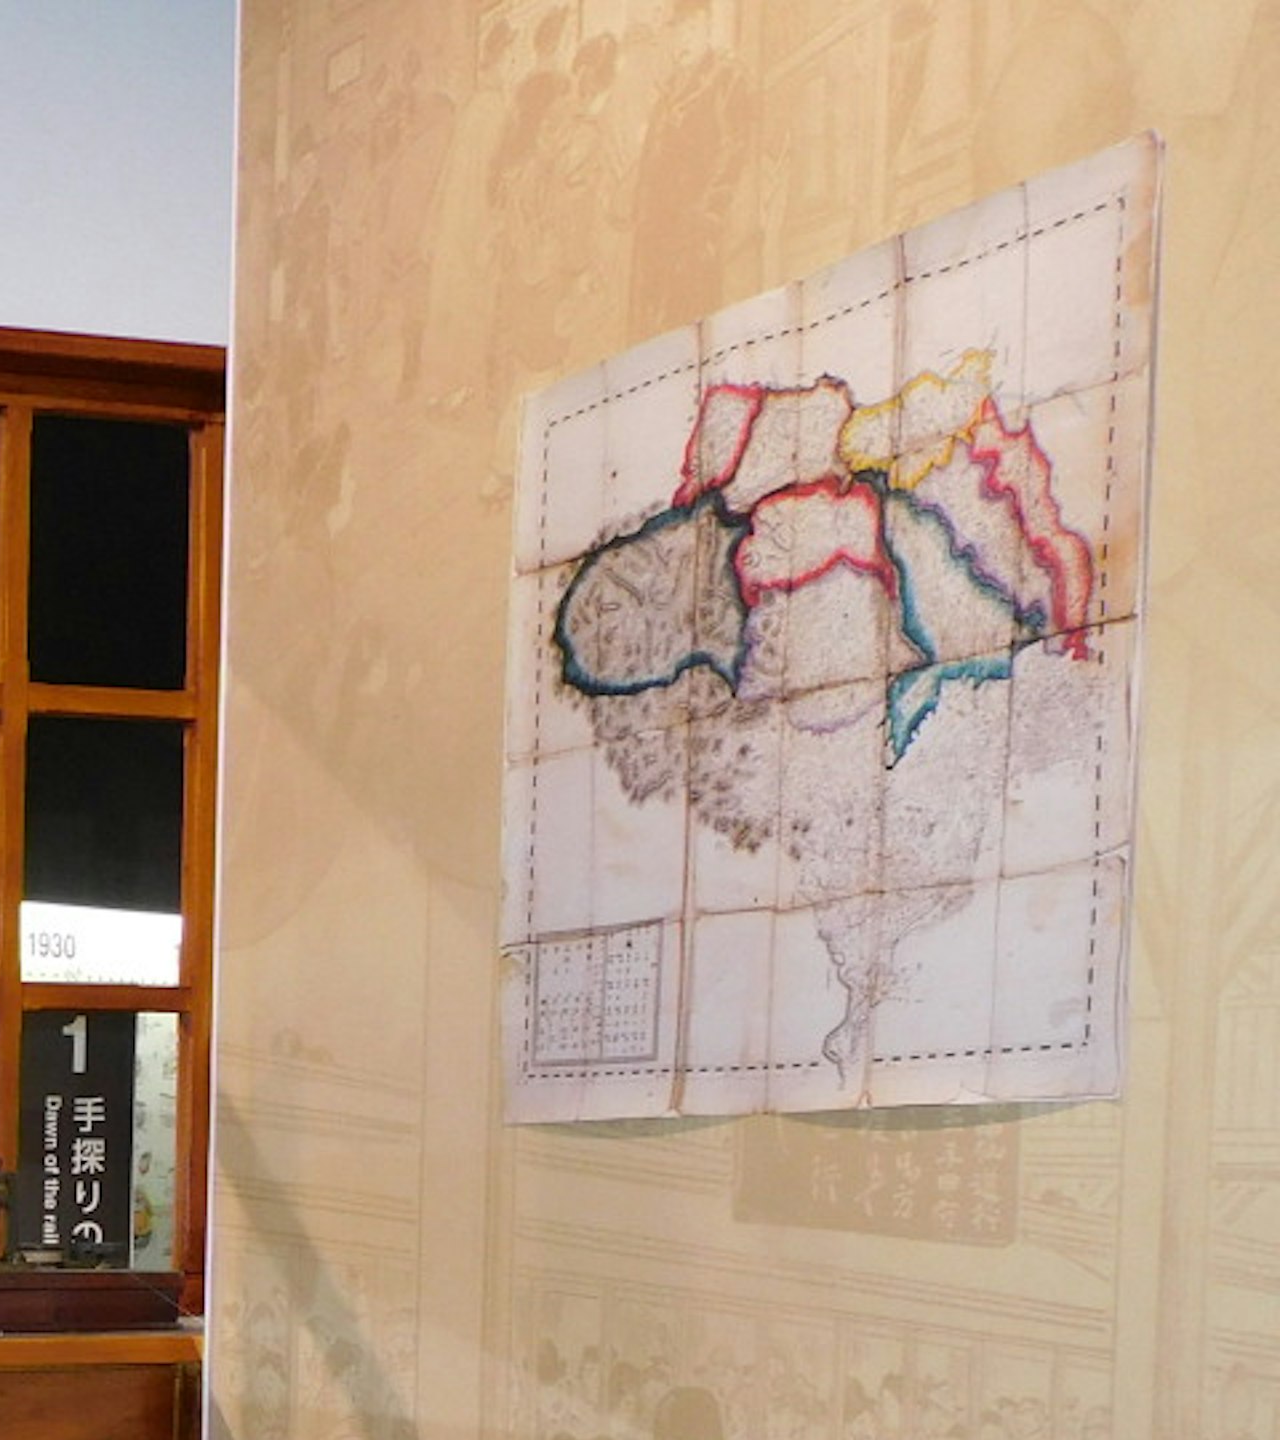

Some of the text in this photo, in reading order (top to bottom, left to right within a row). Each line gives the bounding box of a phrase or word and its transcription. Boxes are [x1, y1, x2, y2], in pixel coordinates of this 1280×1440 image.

[29, 932, 76, 960] 1930
[62, 1014, 88, 1074] 1
[42, 1094, 63, 1245] Dawn of the rail
